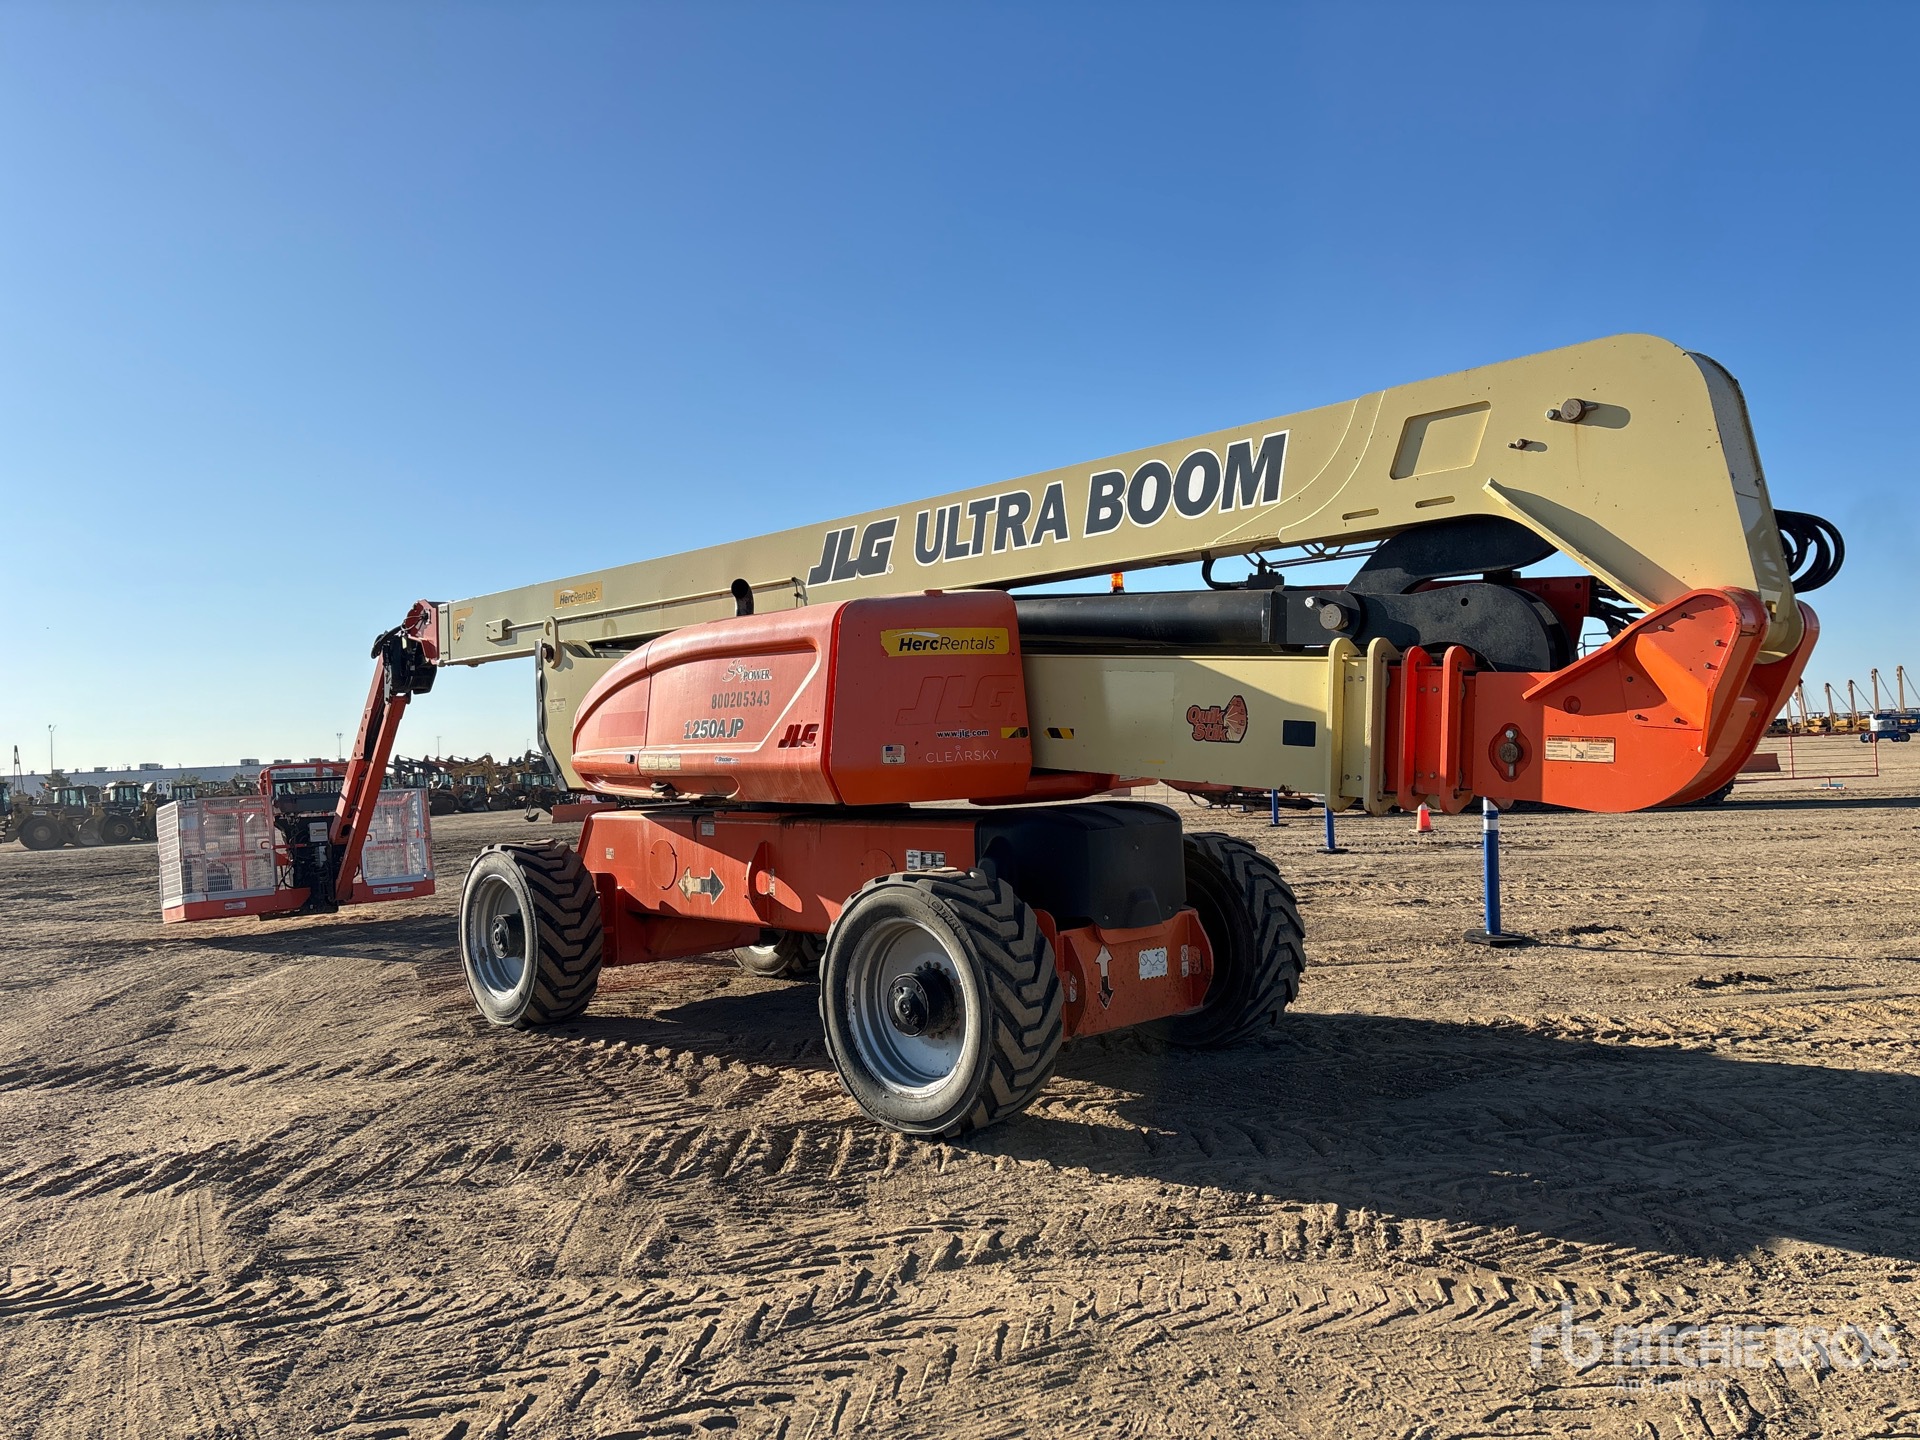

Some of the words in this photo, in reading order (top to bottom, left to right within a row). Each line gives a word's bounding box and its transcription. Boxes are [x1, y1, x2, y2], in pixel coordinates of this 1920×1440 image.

[807, 516, 898, 587] JLG
[914, 480, 1070, 566] ULTRA
[1083, 429, 1290, 538] BOOM
[711, 689, 770, 709] 800205343
[683, 717, 744, 740] 1250AJP
[777, 723, 819, 749] JLG
[936, 728, 989, 738] www.jlg.com
[925, 749, 999, 763] CLEARSKY
